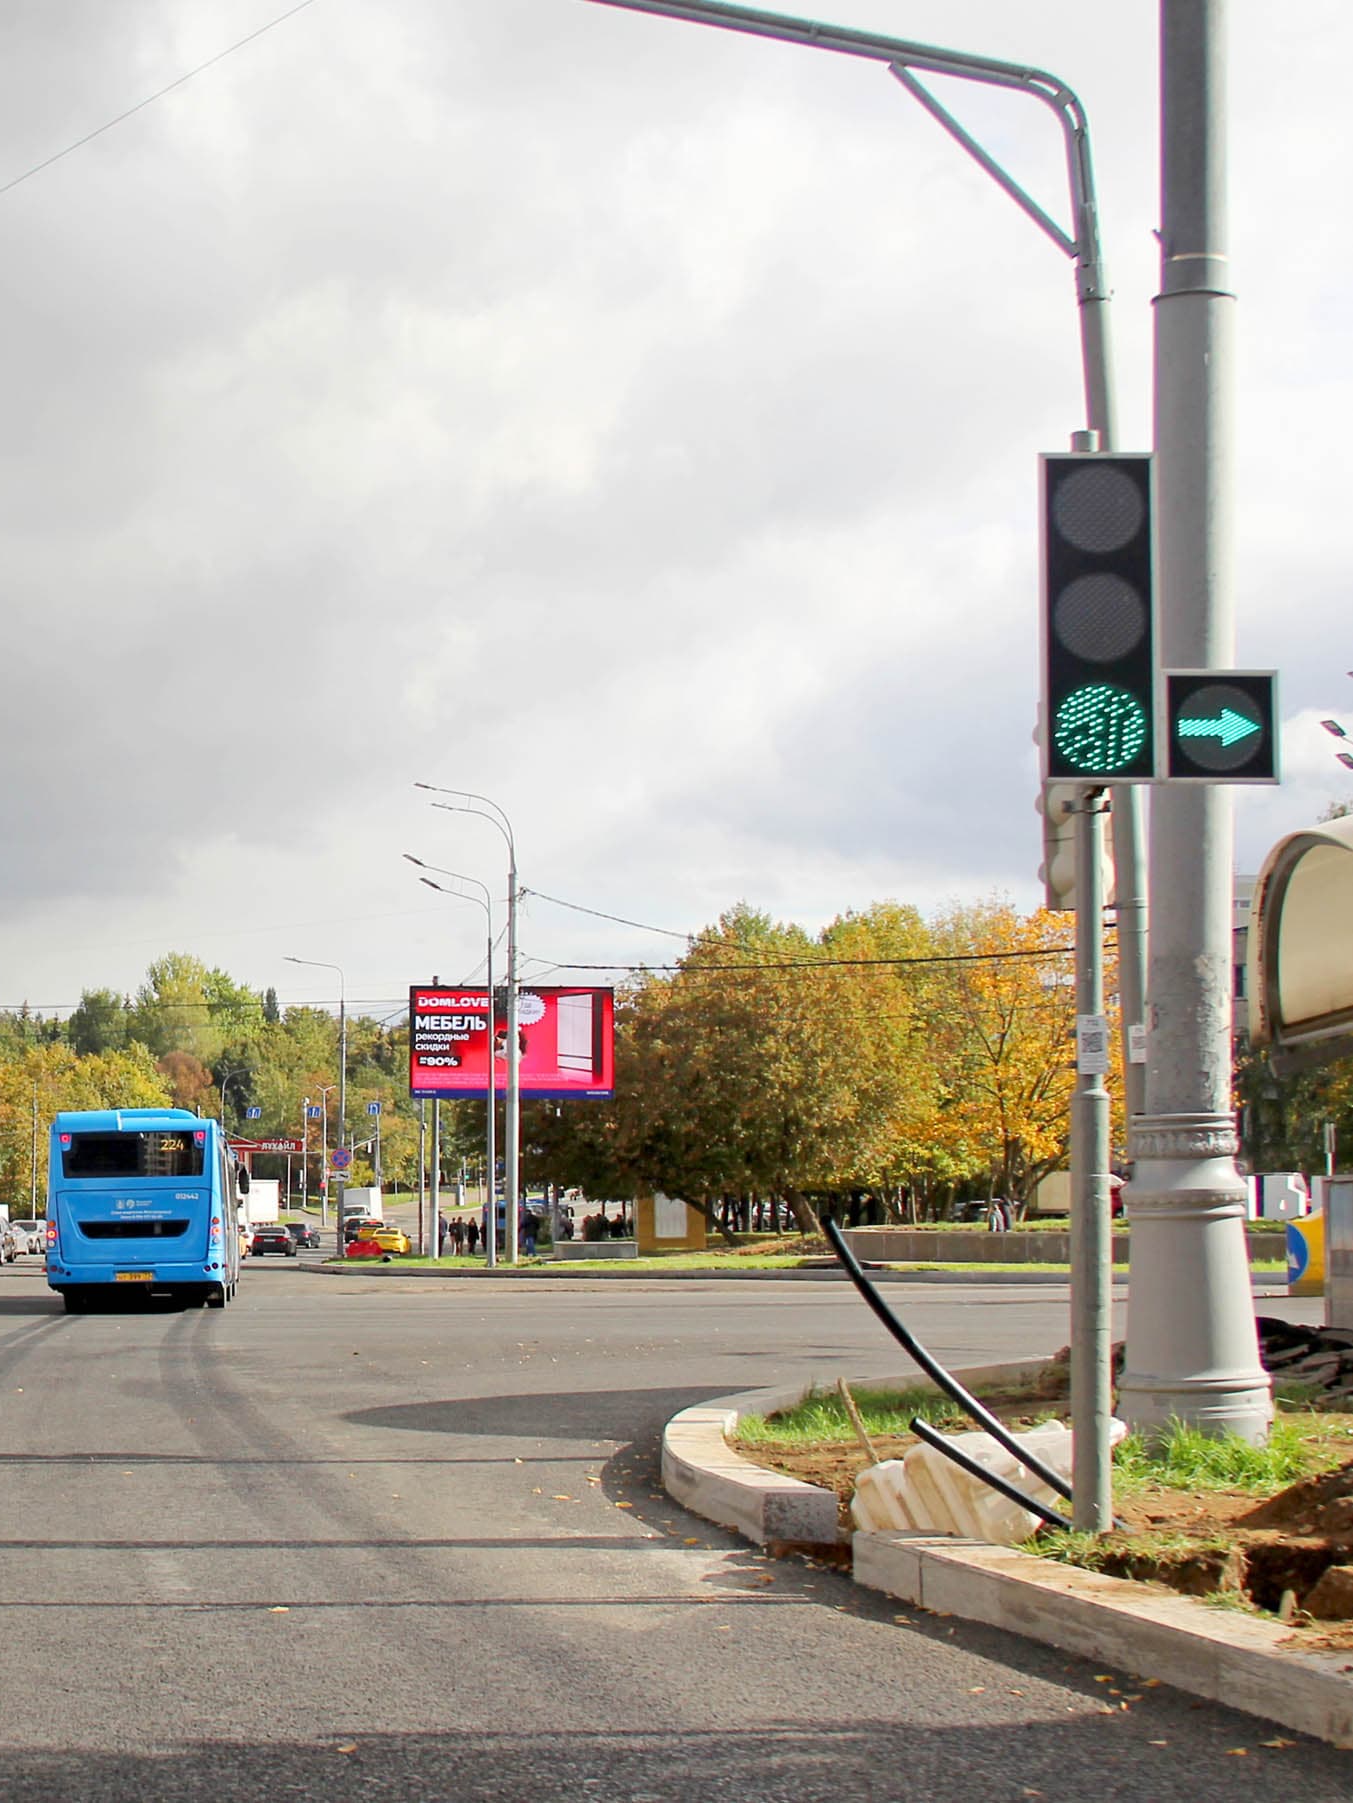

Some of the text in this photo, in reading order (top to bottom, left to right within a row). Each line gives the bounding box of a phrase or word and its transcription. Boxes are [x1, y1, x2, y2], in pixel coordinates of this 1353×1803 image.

[418, 996, 489, 1007] DOMLOVE
[415, 1015, 487, 1030] МЕБЕЛЬ
[415, 1033, 470, 1042] рекордные
[415, 1043, 450, 1051] скидки
[160, 1139, 184, 1151] 224
